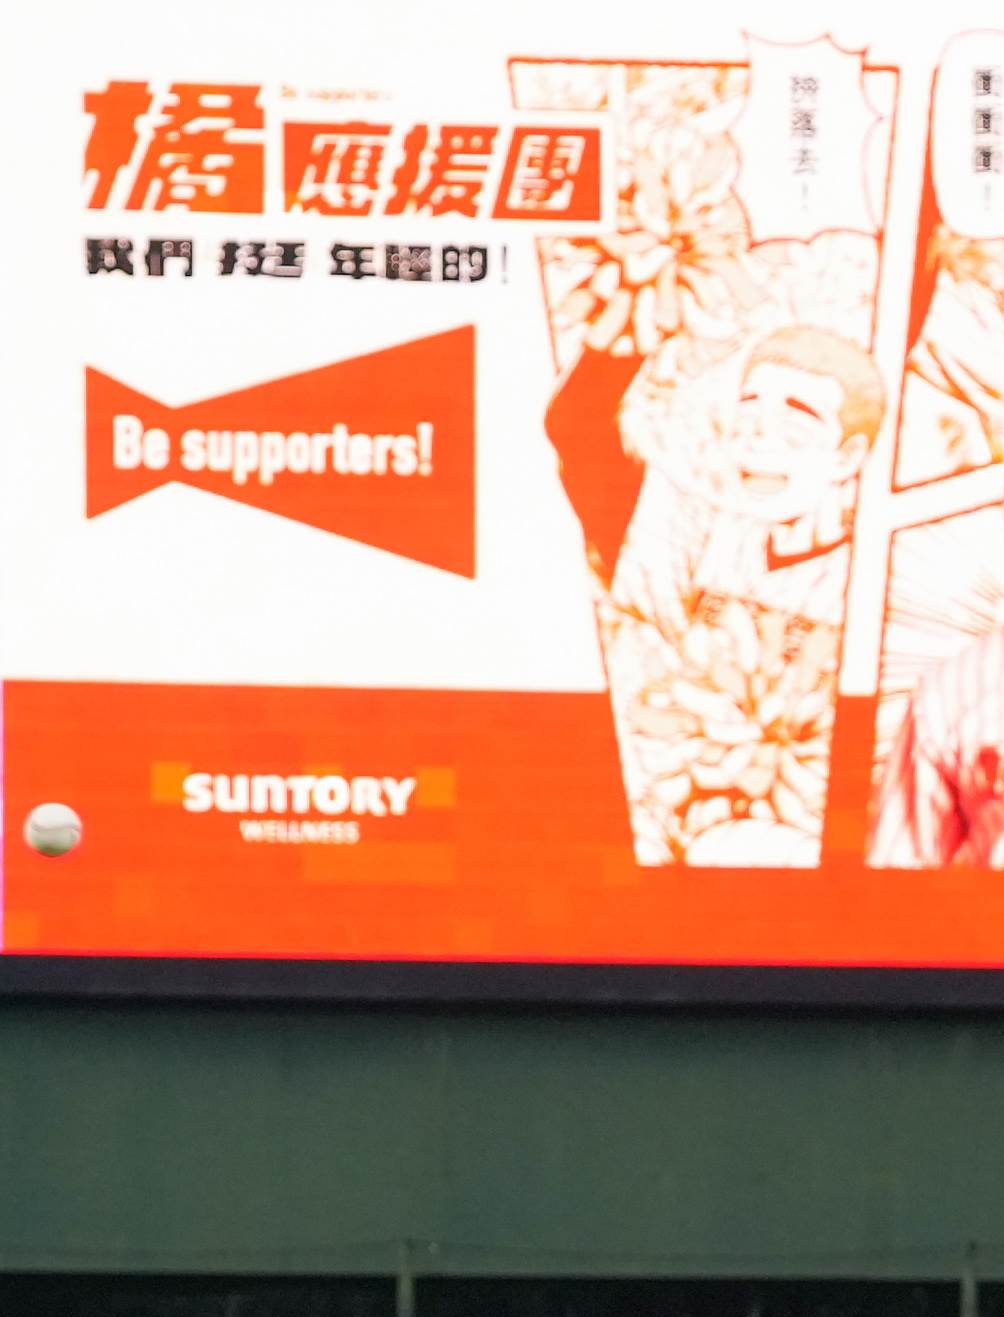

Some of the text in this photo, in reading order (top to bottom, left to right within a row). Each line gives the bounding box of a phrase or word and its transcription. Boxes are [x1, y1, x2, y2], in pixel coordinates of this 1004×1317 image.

[112, 414, 434, 485] Be supporters!
[182, 772, 417, 817] SUNTORY
[239, 819, 360, 844] WELLNESS
